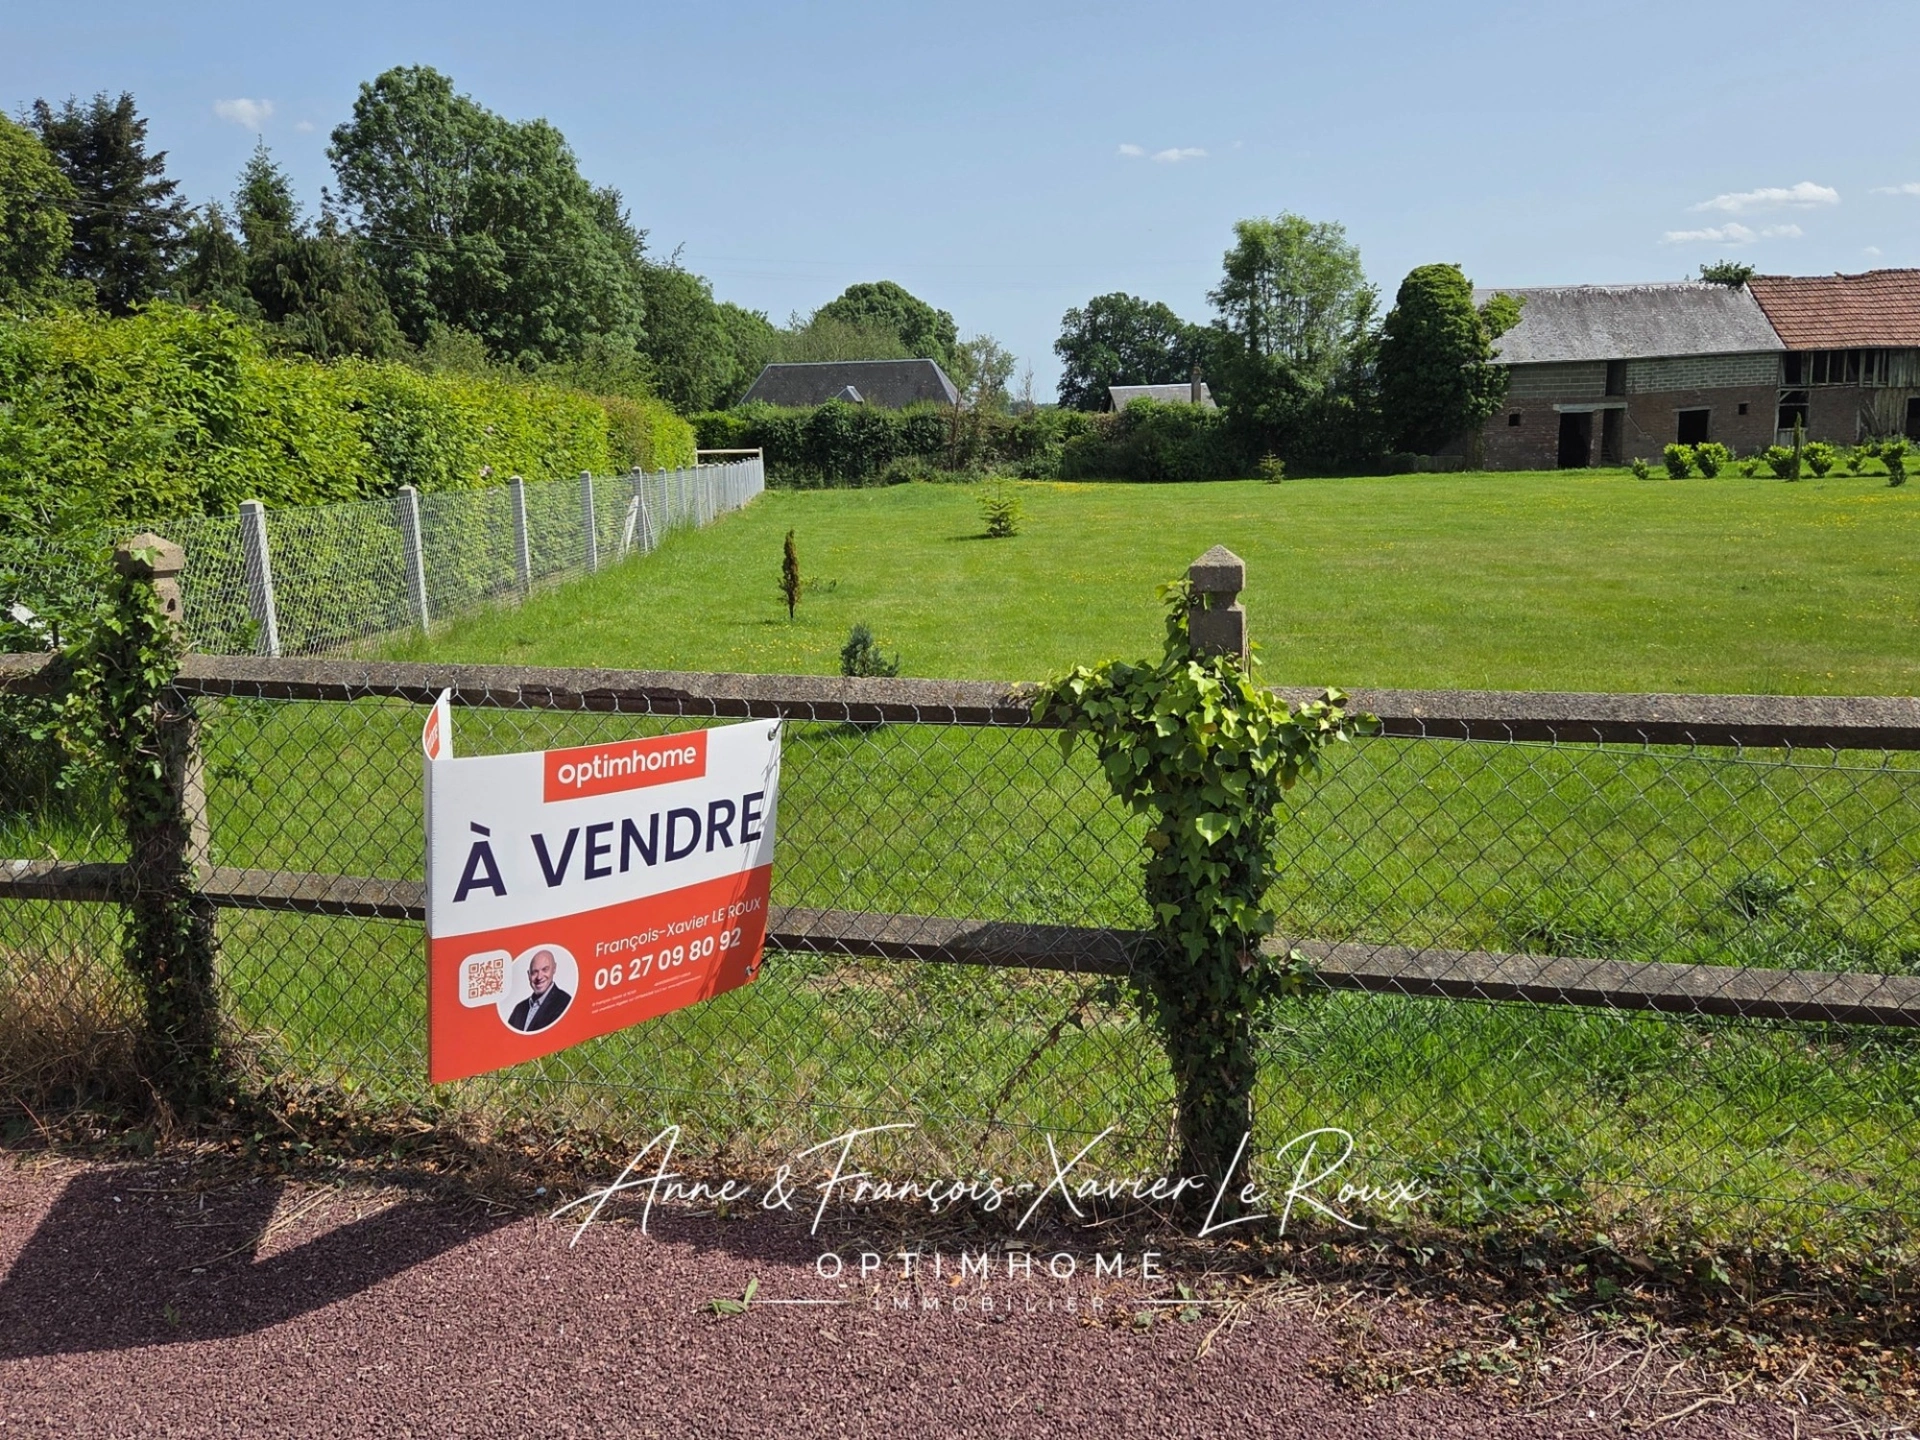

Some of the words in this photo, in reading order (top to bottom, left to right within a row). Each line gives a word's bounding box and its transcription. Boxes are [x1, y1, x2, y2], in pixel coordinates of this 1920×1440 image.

[558, 744, 697, 788] optimhome
[453, 821, 508, 903] À
[531, 791, 765, 888] VENDRE
[596, 914, 709, 957] François-Xavier
[712, 907, 725, 924] LE
[728, 897, 762, 919] ROUX
[594, 964, 623, 990] 06
[628, 955, 654, 981] 27
[658, 945, 684, 971] 09
[689, 936, 715, 961] 80
[720, 927, 742, 951] 92
